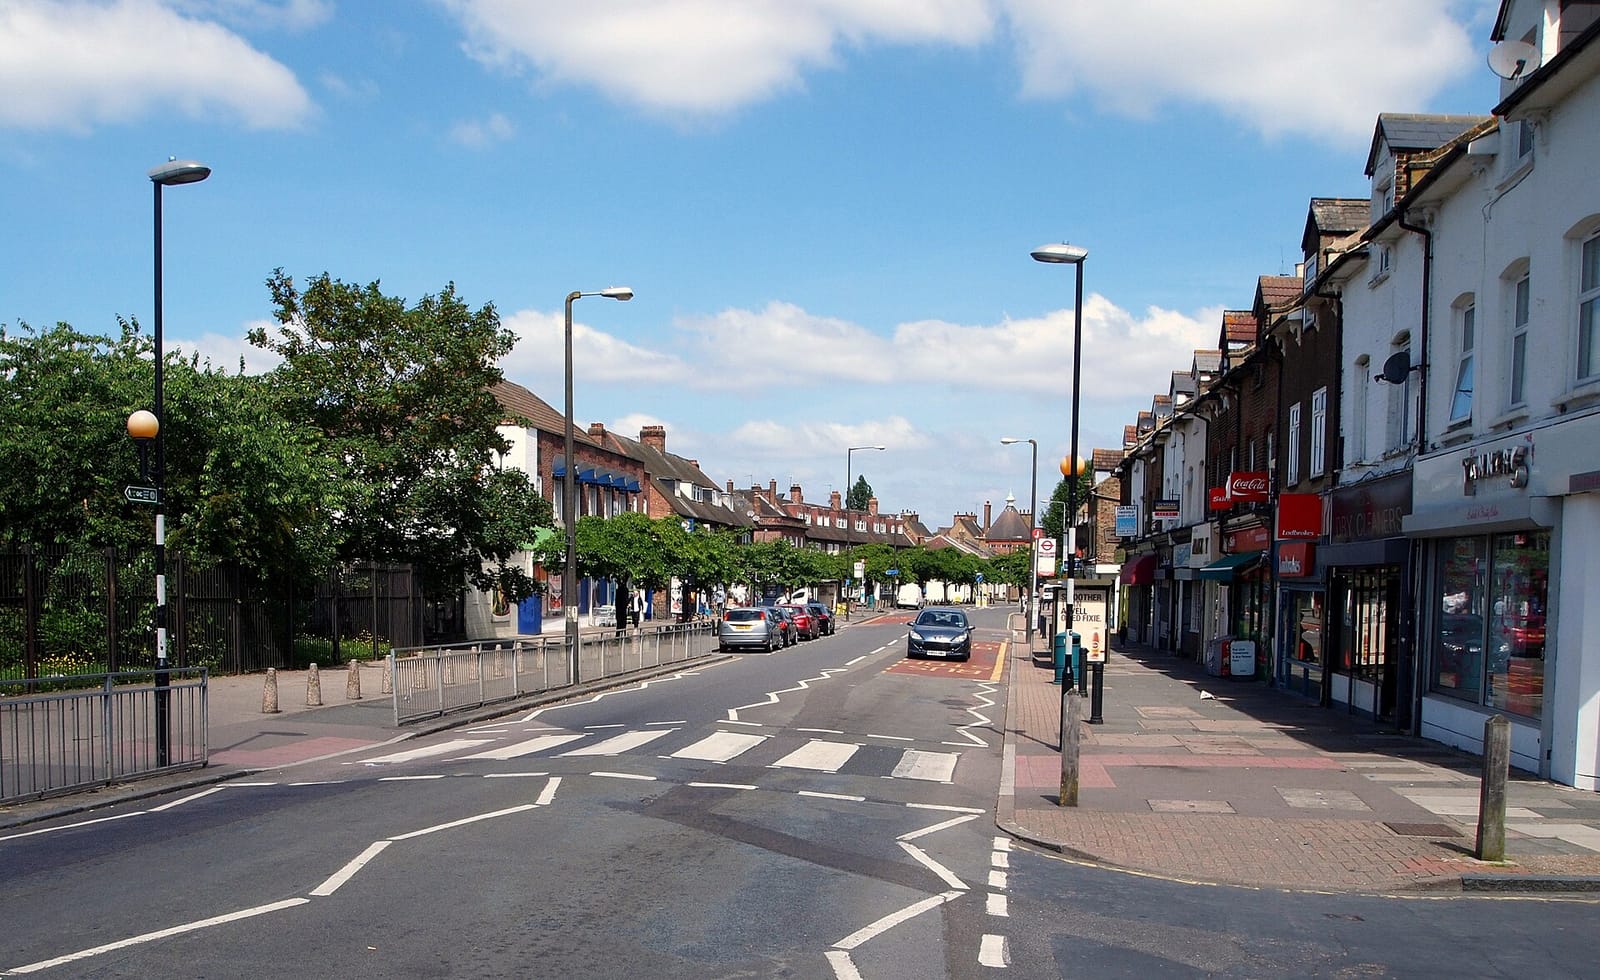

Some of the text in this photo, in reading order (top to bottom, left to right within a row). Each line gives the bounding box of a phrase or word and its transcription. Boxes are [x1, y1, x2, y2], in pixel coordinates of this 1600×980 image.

[1335, 505, 1403, 537] DRY CLEANERS
[1282, 529, 1314, 537] Ladbrokes
[1061, 593, 1102, 601] SOOTHER
